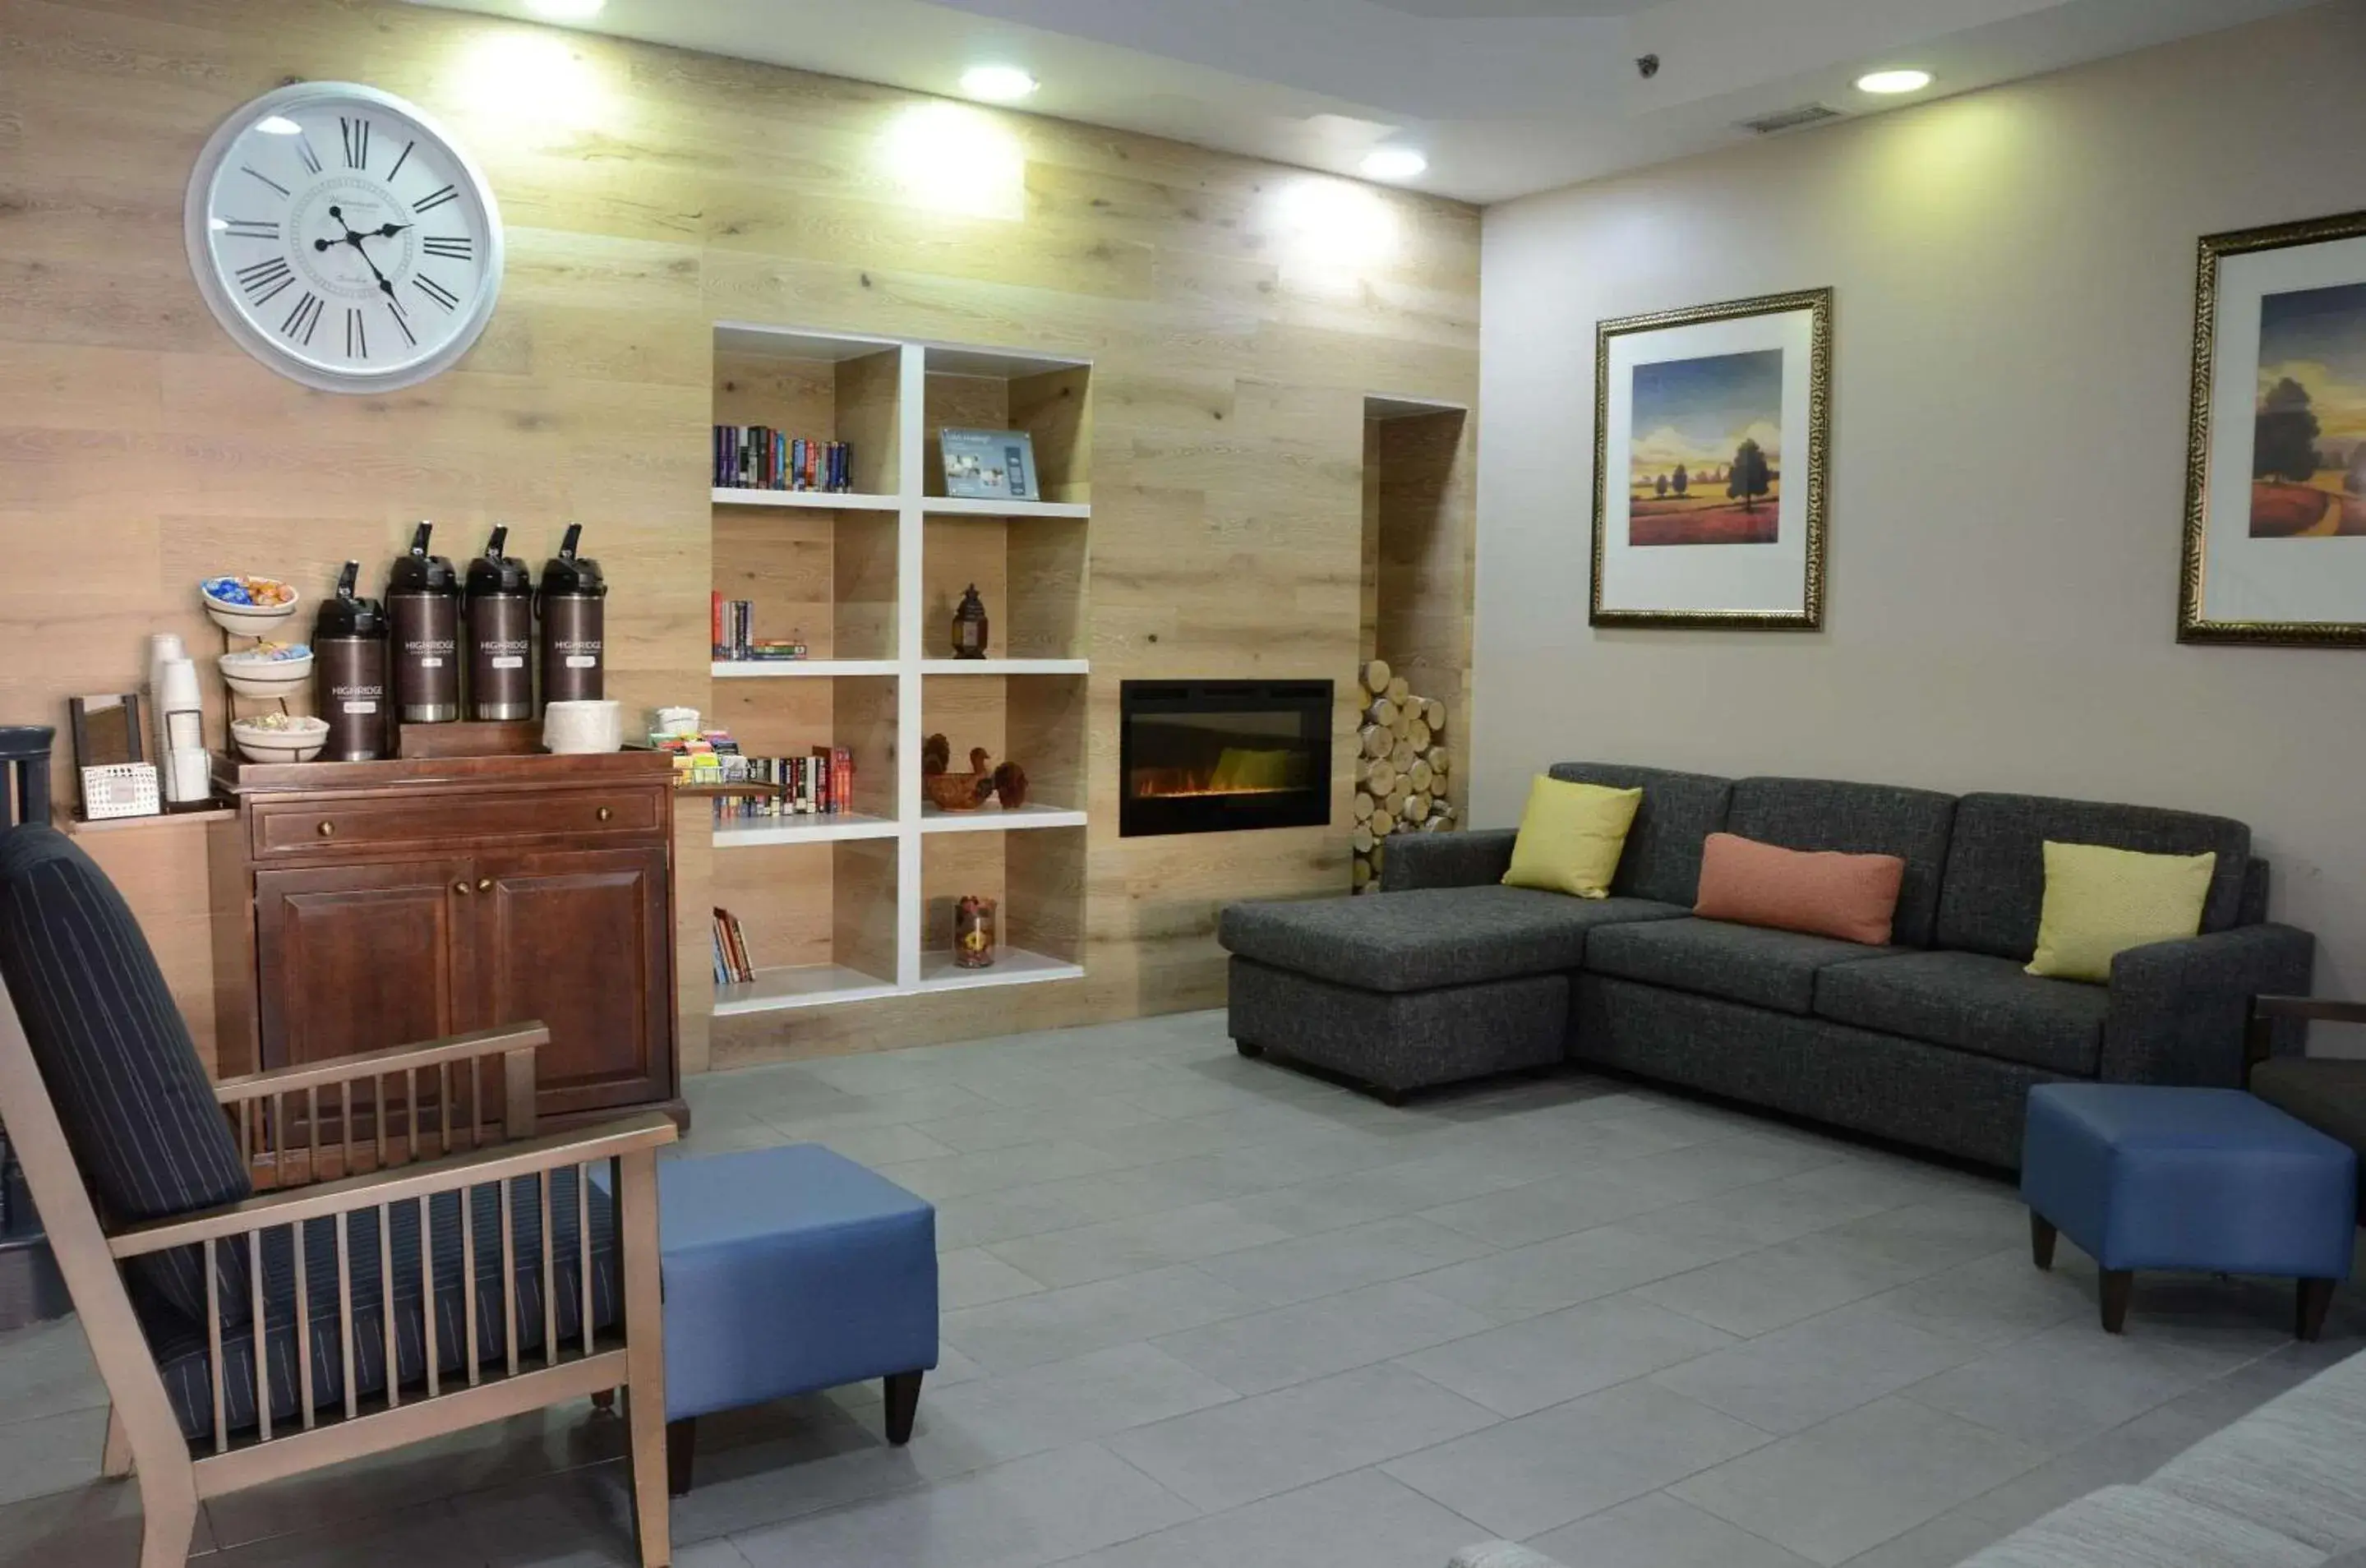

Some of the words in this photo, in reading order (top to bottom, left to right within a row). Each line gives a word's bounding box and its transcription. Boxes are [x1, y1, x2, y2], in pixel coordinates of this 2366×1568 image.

[340, 117, 370, 170] XII
[387, 141, 414, 182] I
[412, 184, 459, 214] II
[423, 236, 472, 261] III
[235, 256, 296, 307] VIII
[280, 291, 325, 346] VII
[405, 640, 455, 649] HIGHRIDGE
[480, 640, 528, 649] HIGHRIDGE
[555, 640, 602, 649] HIGHRIDGE
[332, 685, 383, 695] HIGHRIDGE
